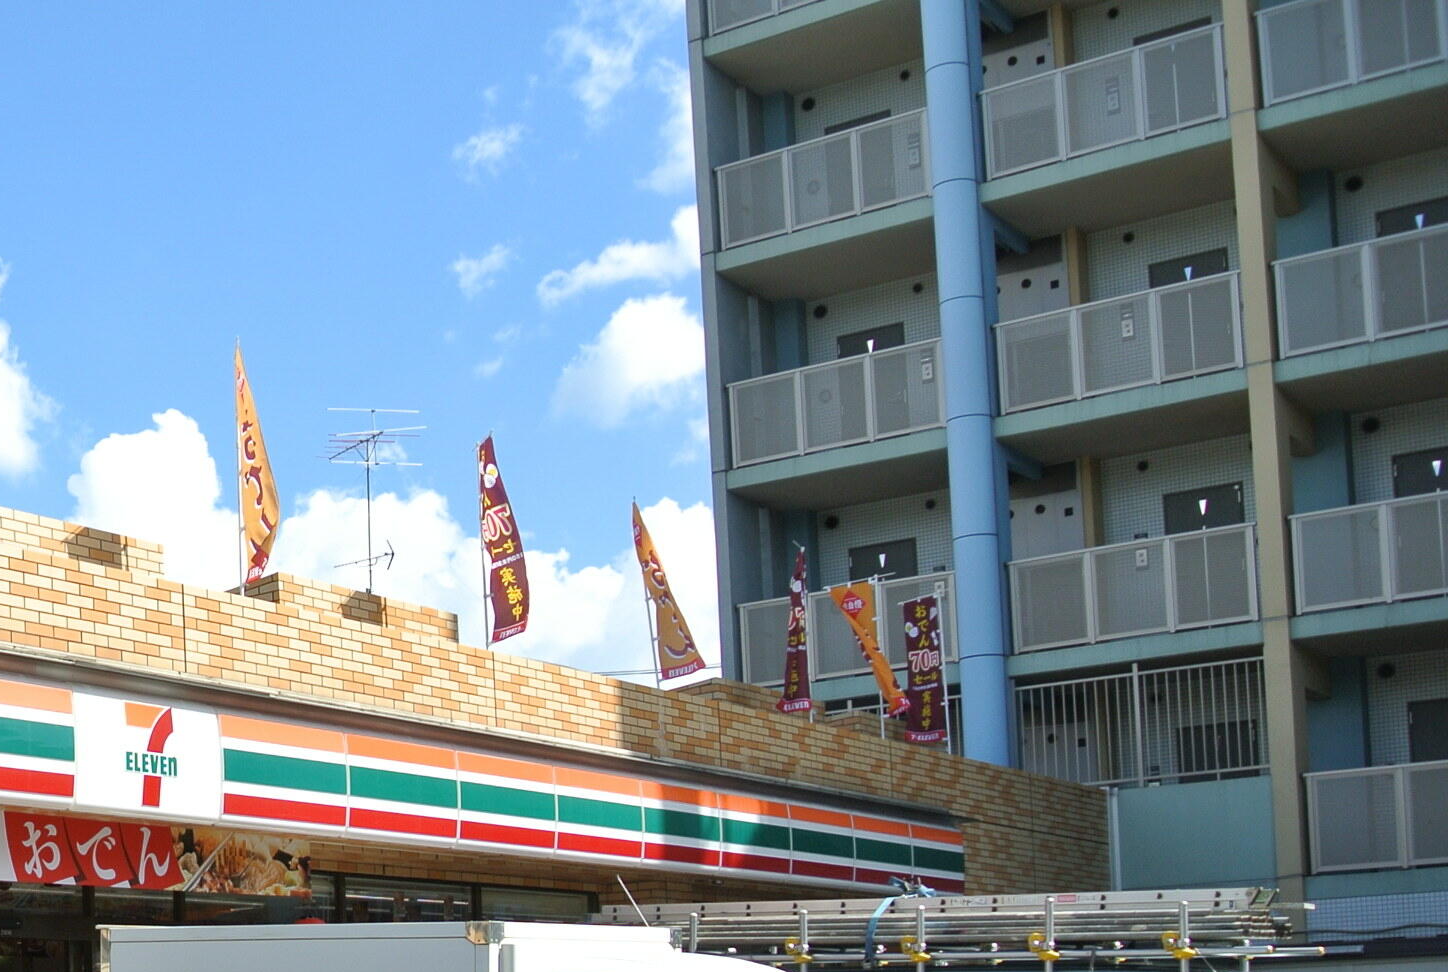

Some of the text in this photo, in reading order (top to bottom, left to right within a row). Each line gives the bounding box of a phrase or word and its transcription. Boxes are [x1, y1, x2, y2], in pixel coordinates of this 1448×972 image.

[914, 604, 930, 648] おでん
[909, 649, 940, 673] 70円
[22, 820, 173, 887] おでん
